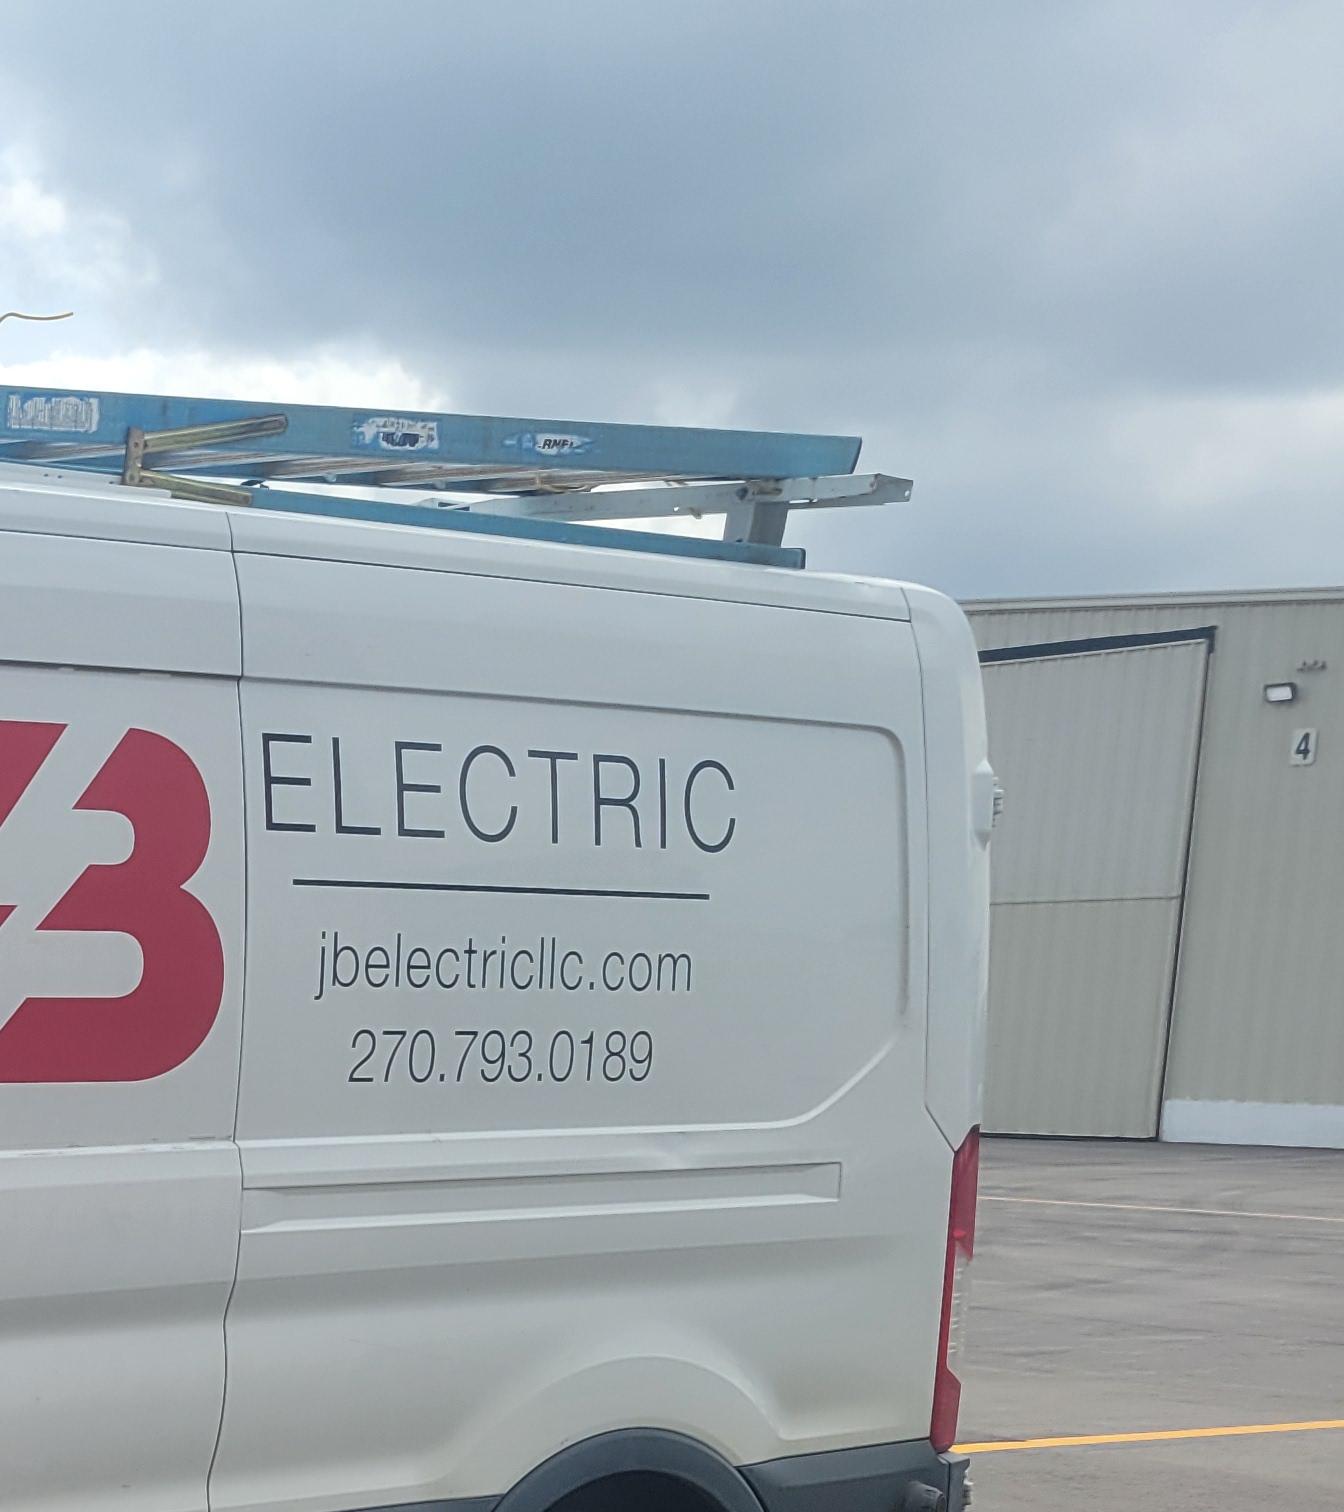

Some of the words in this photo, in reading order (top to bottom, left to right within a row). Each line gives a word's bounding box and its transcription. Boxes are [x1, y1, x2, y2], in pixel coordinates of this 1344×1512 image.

[1294, 732, 1311, 761] 4
[261, 732, 736, 854] ELECTRIC
[313, 930, 692, 1001] jbelectricllc.com
[347, 1029, 654, 1083] 270.793.0189
